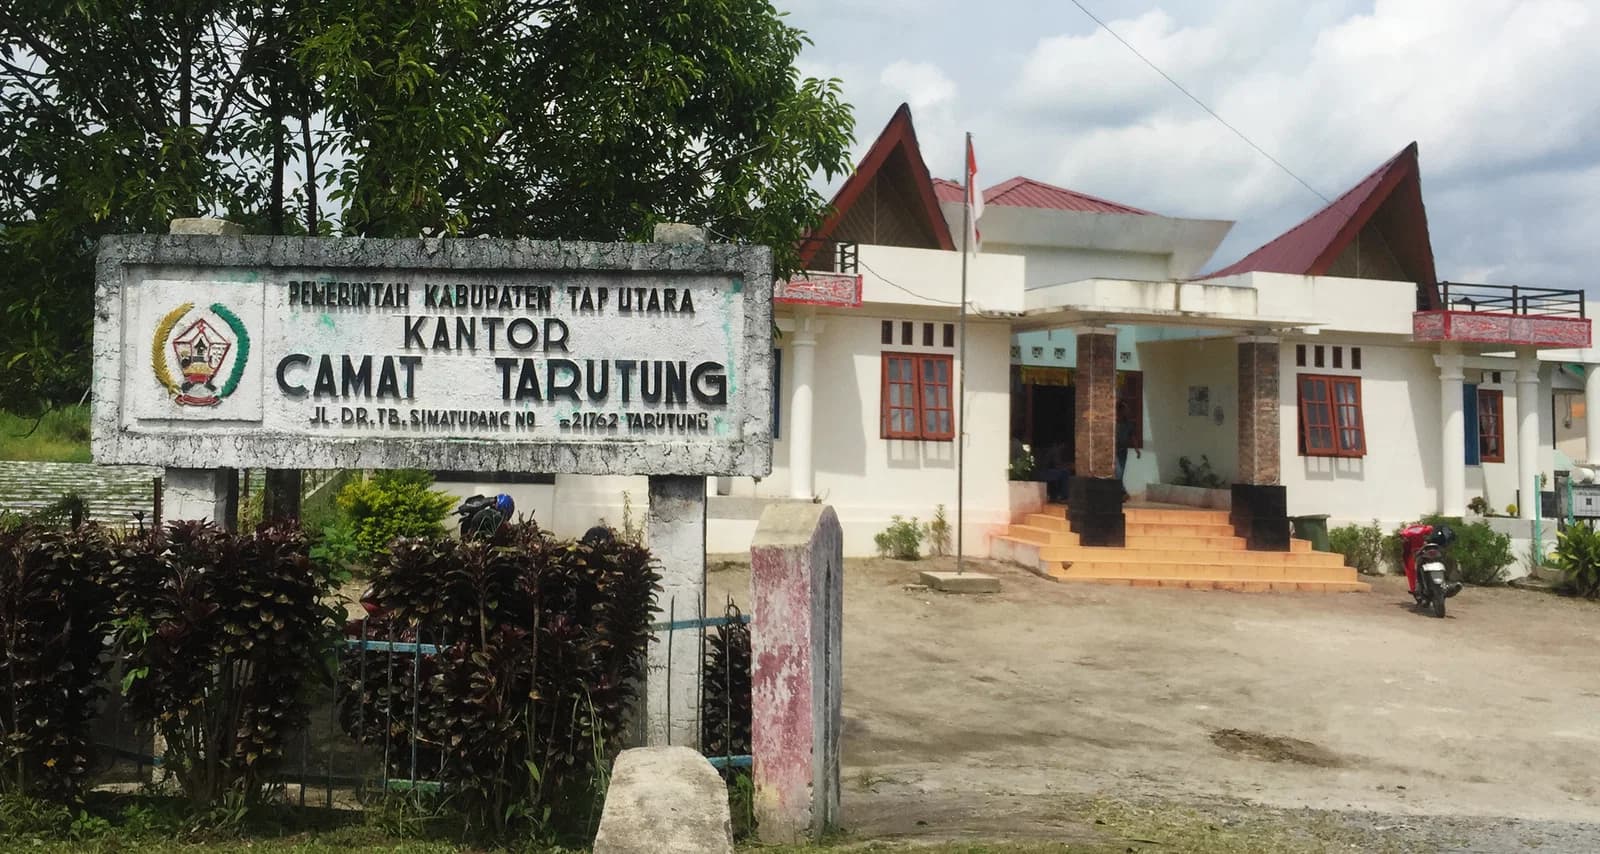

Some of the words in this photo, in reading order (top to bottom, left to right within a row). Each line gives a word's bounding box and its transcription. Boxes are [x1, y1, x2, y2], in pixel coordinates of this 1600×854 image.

[288, 280, 409, 307] PEMERINTAH
[424, 284, 552, 310] KABUPATEN
[567, 286, 609, 311] TAP
[618, 287, 695, 313] UTARA
[403, 315, 569, 352] KANTOR
[276, 353, 422, 400] CAMAT
[495, 357, 727, 405] TARUTUNG
[626, 412, 709, 431] TARUTUNG
